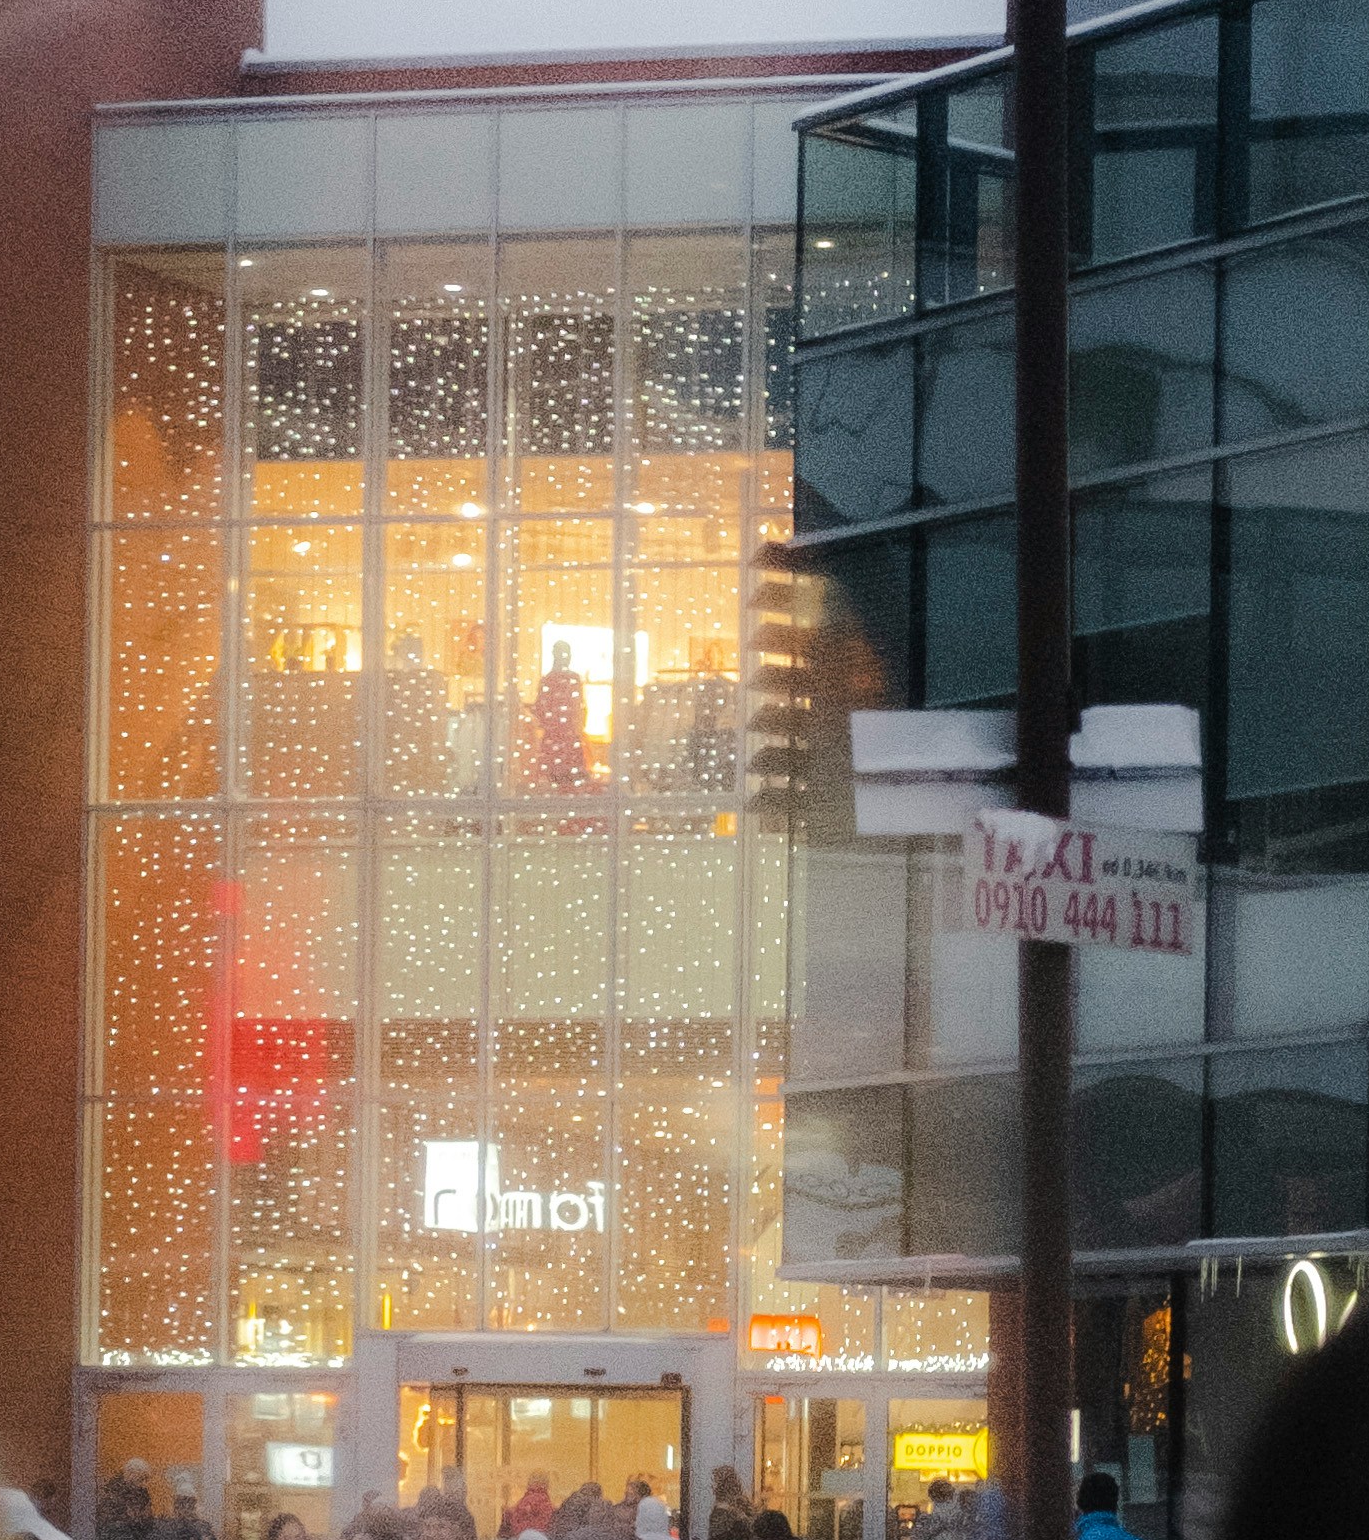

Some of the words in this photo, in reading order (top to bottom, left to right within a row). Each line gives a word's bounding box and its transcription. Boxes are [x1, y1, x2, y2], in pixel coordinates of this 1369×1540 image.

[974, 877, 1048, 934] 0910
[1063, 891, 1117, 942] 444
[1130, 895, 1184, 950] 111
[905, 1444, 963, 1458] DOPPIO
